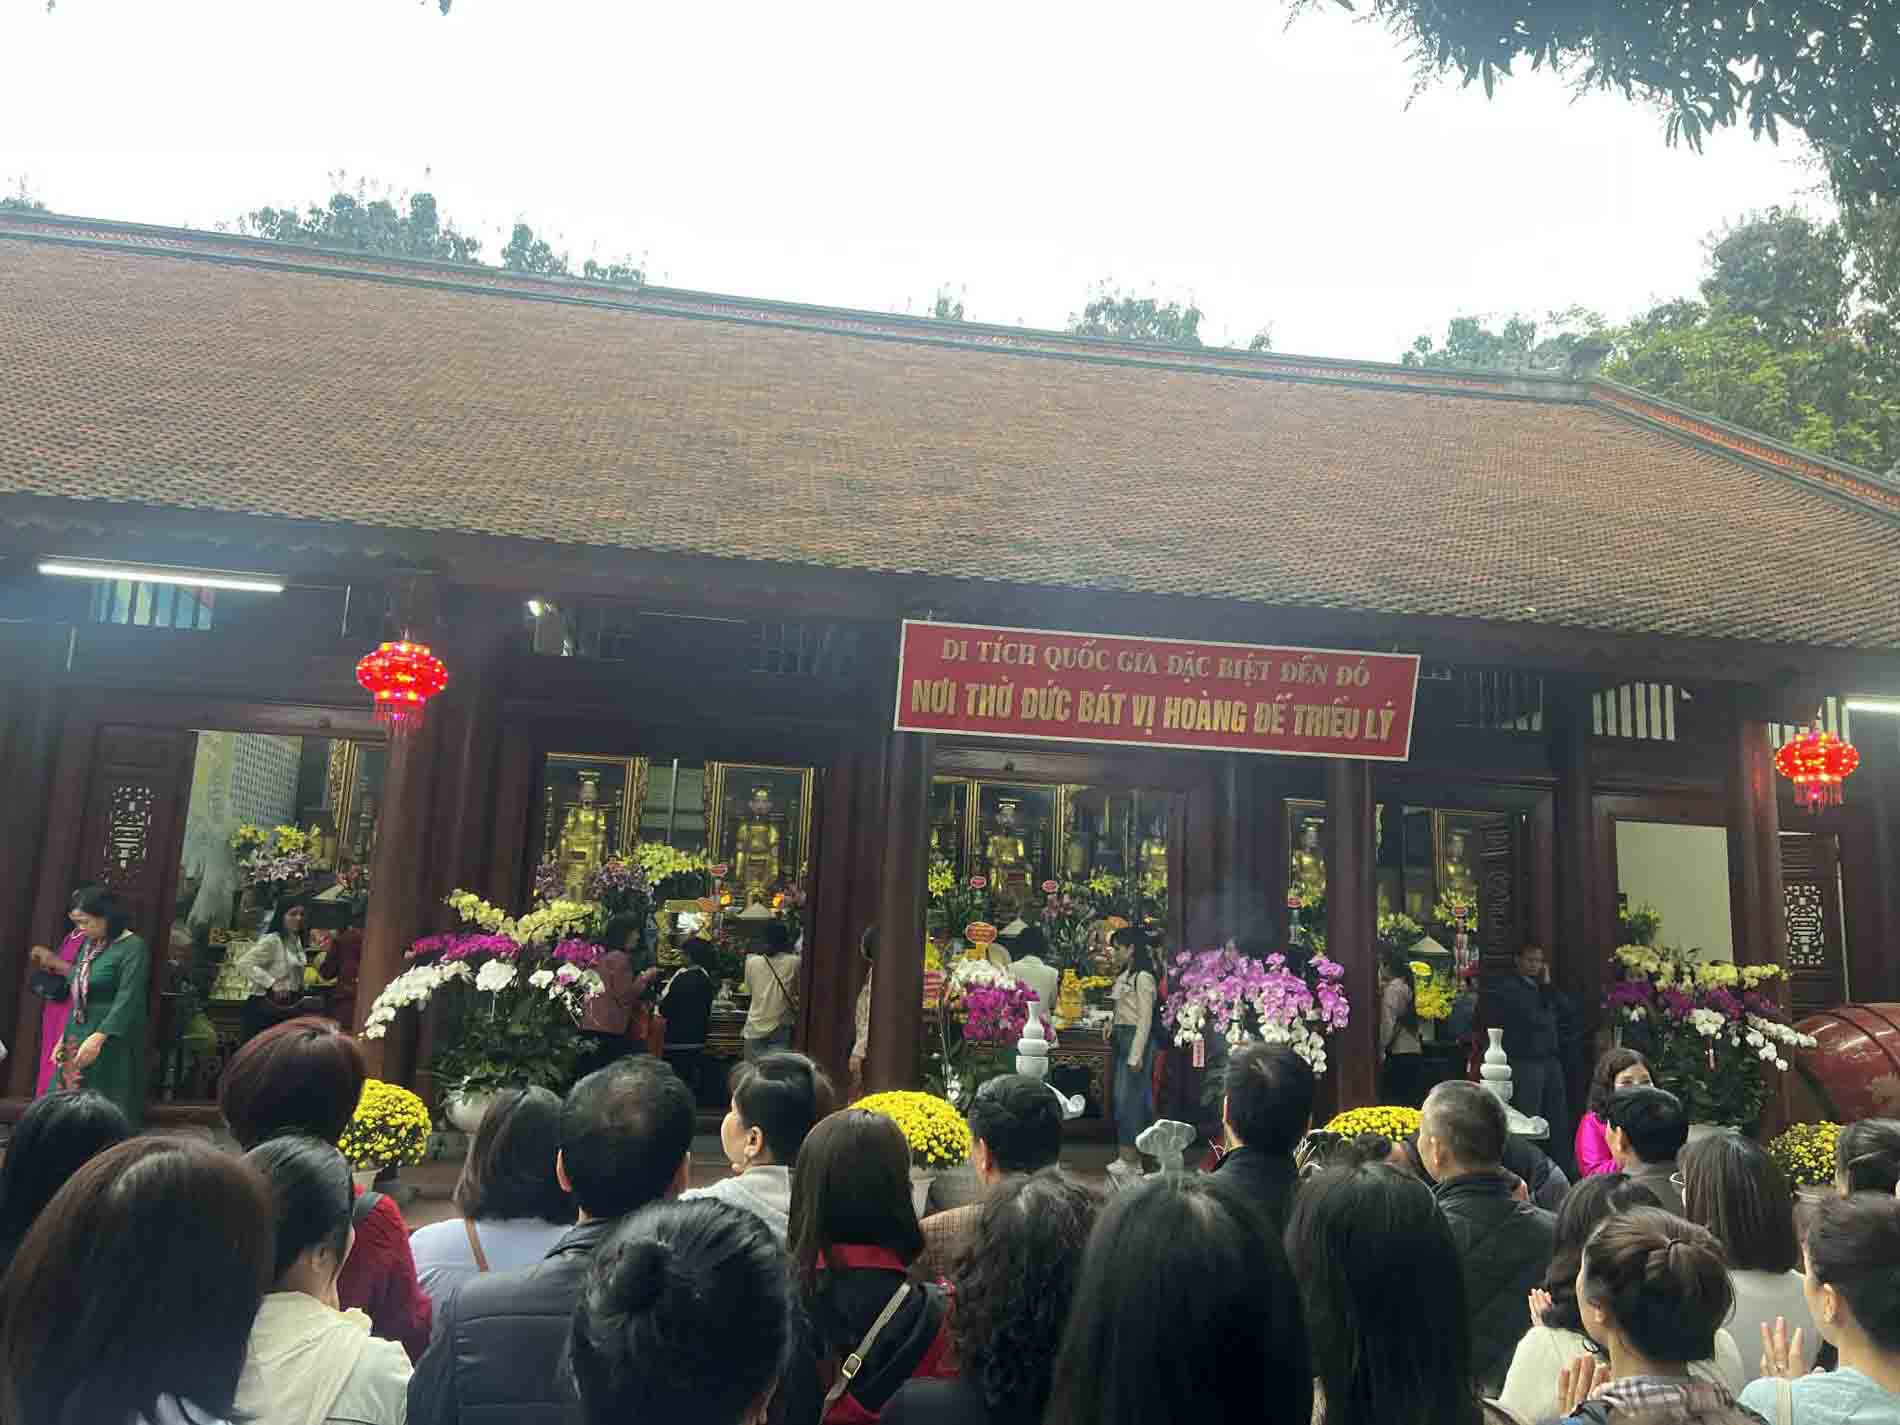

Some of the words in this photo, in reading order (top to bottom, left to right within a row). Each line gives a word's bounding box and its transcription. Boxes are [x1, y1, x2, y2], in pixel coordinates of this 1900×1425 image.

[977, 635, 1037, 665] TÍCH
[1044, 640, 1111, 671] QUỐC
[1117, 651, 1159, 675] GIA
[1167, 650, 1211, 684] ĐẶC
[1217, 652, 1272, 687] BIỆT
[911, 676, 957, 715] NƠI
[965, 674, 1015, 719] THỜ
[1021, 680, 1072, 722] ĐỨC
[1078, 684, 1126, 725] BÁT
[1132, 695, 1156, 736] VỊ
[1163, 690, 1248, 734] HOÀNG
[1255, 692, 1293, 735] ĐẾ
[1364, 700, 1396, 741] LÝ
